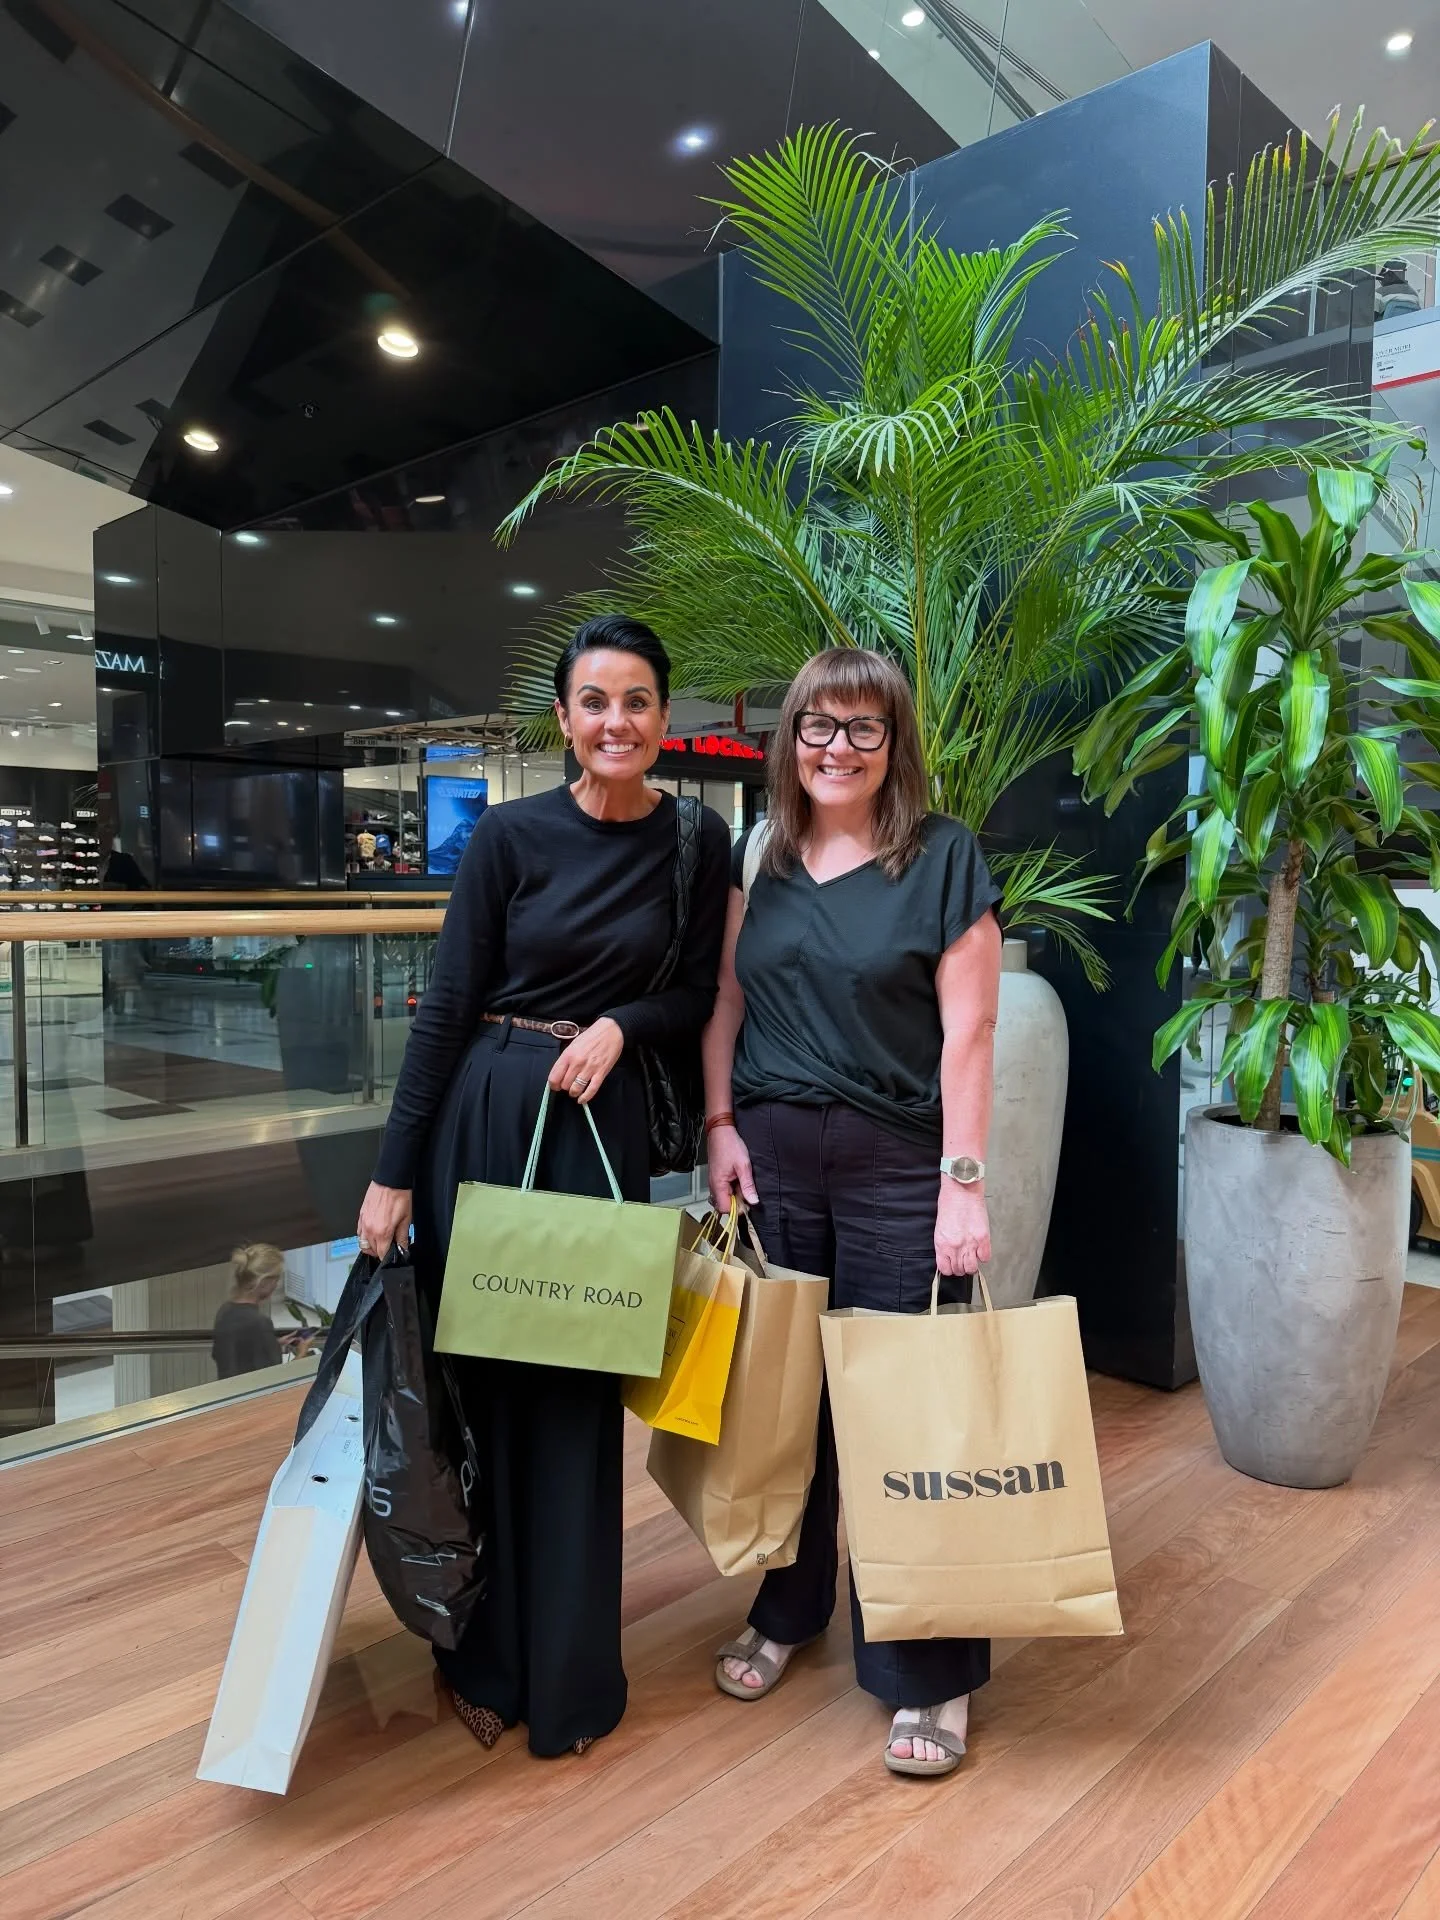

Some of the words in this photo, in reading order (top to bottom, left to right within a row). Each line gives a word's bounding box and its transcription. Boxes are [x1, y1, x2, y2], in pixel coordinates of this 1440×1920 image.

[472, 1273, 575, 1301] COUNTRY
[584, 1286, 643, 1309] ROAD
[882, 1459, 1069, 1501] sussan
